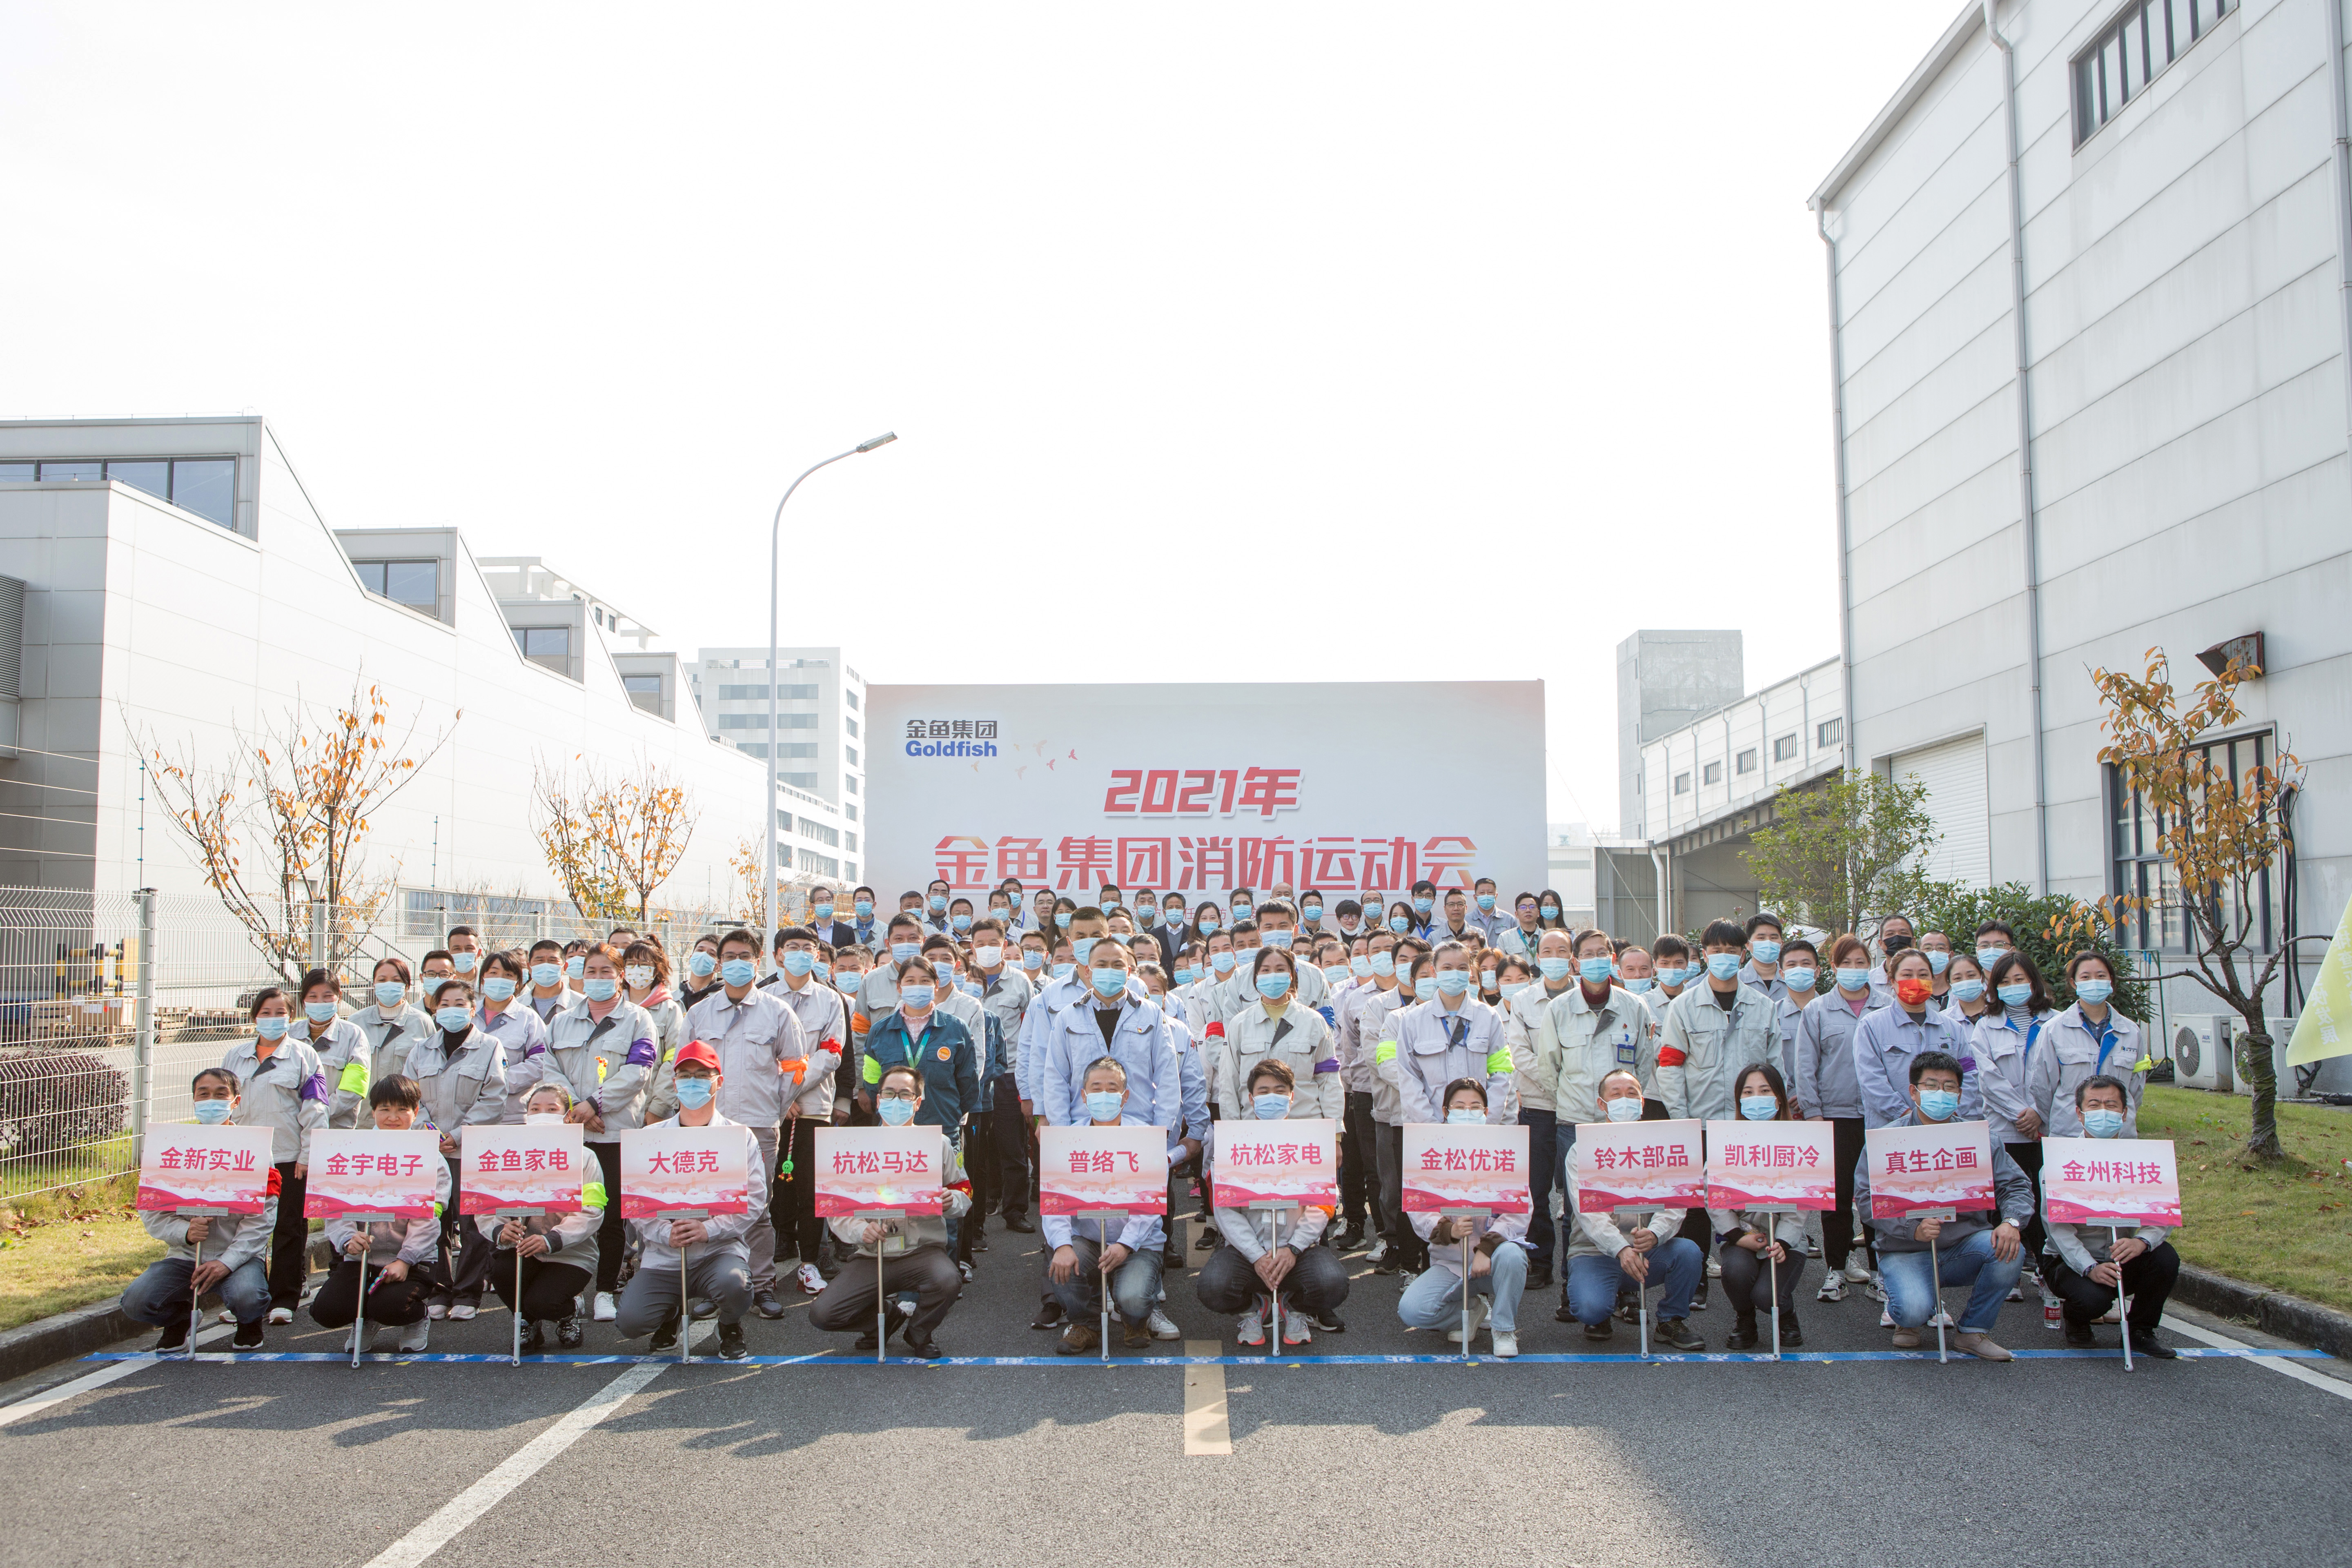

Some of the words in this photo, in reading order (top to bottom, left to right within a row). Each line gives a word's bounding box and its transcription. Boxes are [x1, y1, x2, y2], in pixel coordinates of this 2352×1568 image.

[906, 719, 997, 739] 金鱼集团
[905, 740, 997, 757] Goldfish
[1104, 766, 1301, 815] 2021年
[935, 835, 1477, 891] 金鱼集团消防运动会
[159, 1146, 255, 1172] 金新实业
[326, 1153, 423, 1176] 金宇电子
[478, 1148, 570, 1172] 金鱼家电
[648, 1149, 719, 1175] 大德克
[833, 1150, 929, 1174] 杭松马达
[1068, 1150, 1139, 1174] 普络飞
[1230, 1143, 1323, 1166] 杭松家电
[1421, 1148, 1515, 1172] 金松优诺
[1594, 1145, 1688, 1170] 铃木部品
[1725, 1144, 1820, 1168] 凯利厨冷
[1886, 1146, 1977, 1175] 真生企画
[2062, 1160, 2163, 1184] 金州科技
